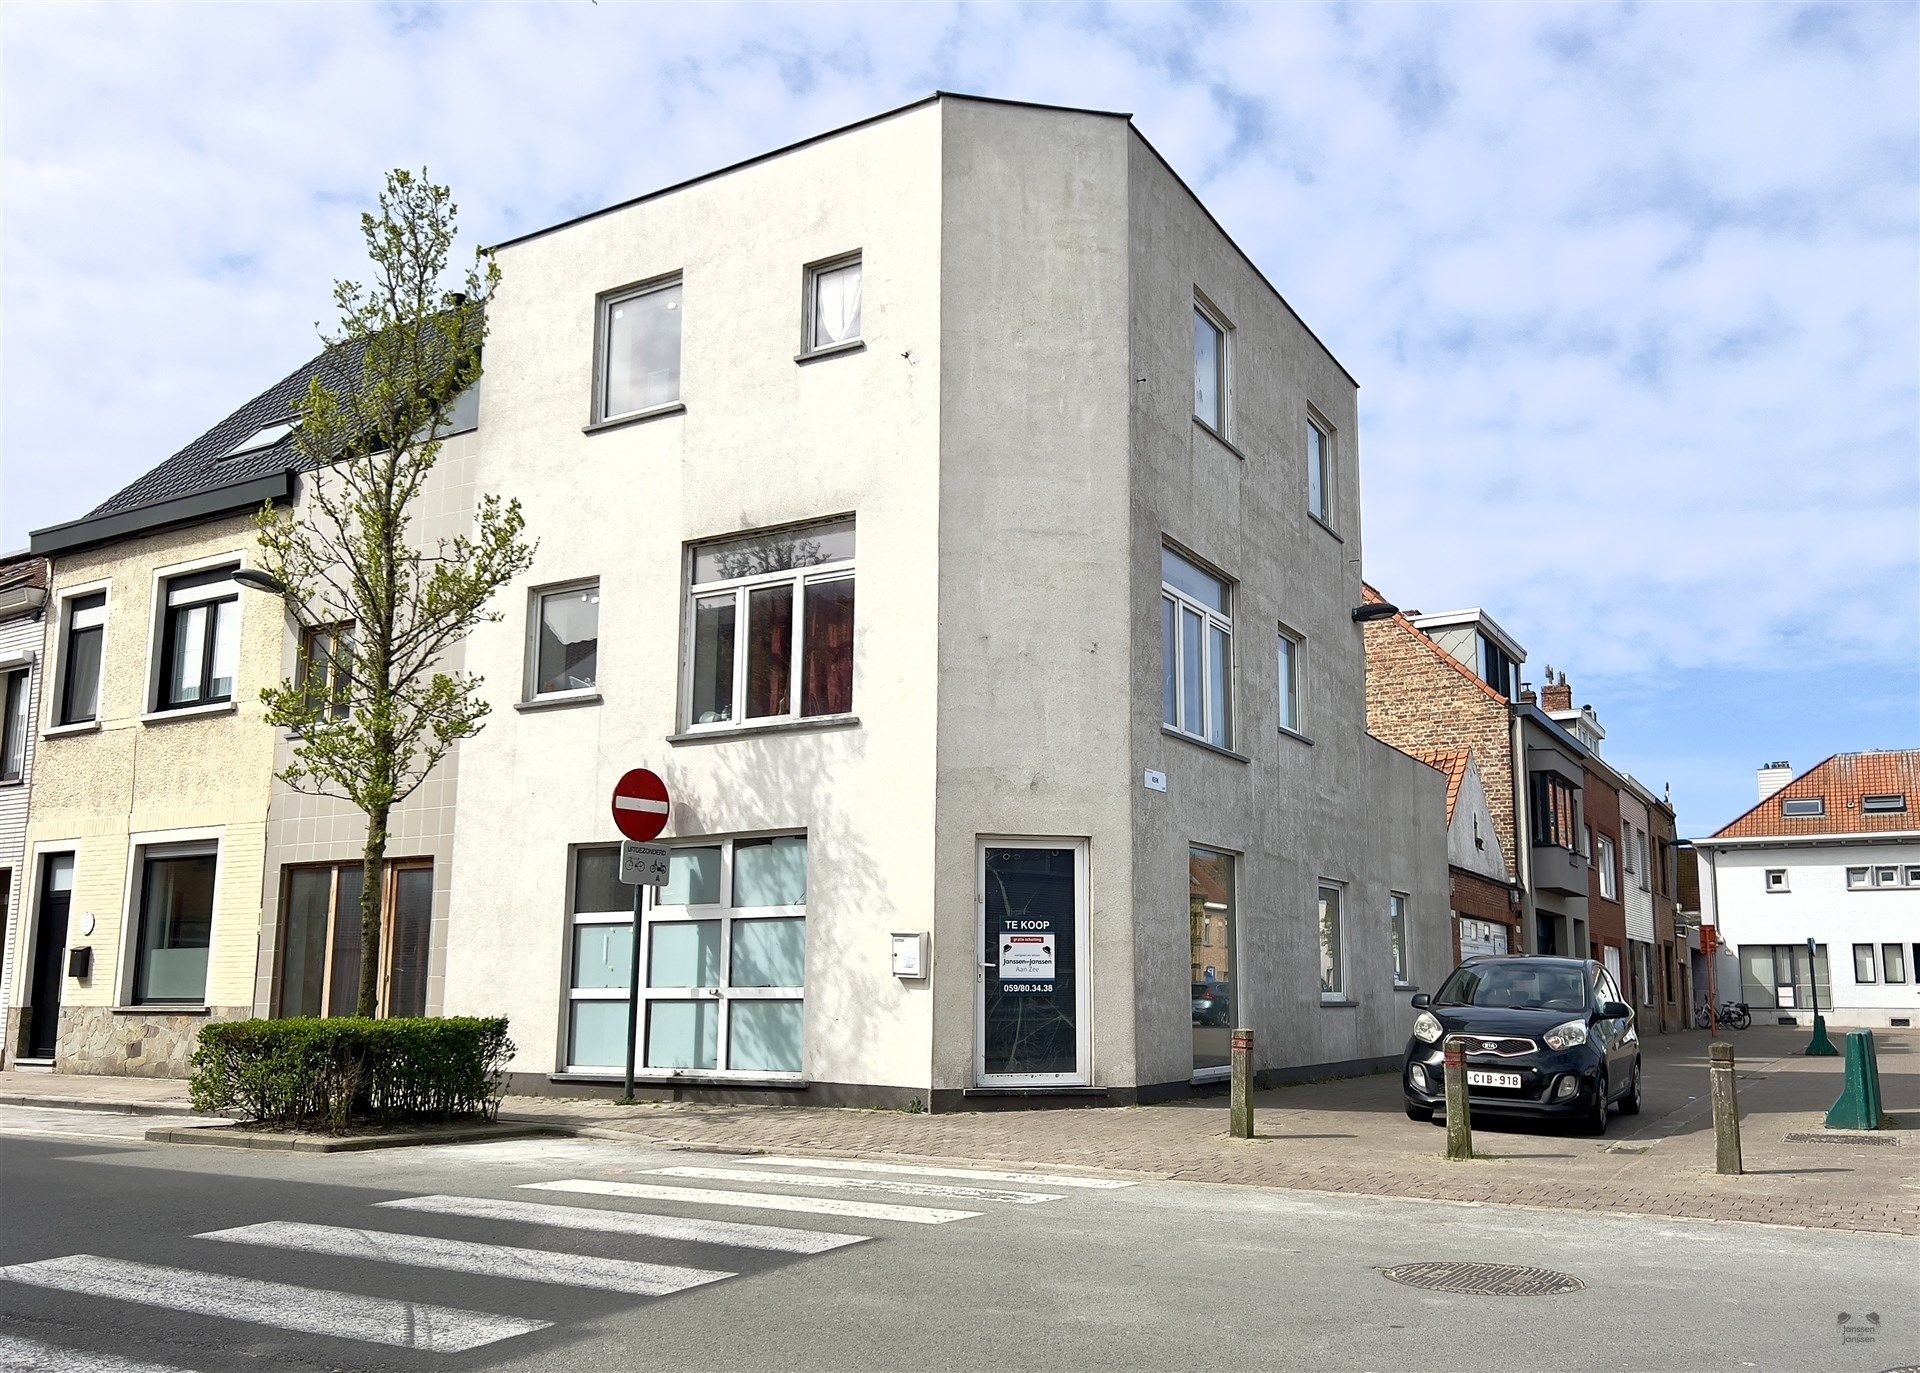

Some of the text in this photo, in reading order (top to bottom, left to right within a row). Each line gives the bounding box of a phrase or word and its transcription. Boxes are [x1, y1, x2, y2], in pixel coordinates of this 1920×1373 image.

[628, 846, 667, 856] UITGEZONDERD
[1005, 921, 1050, 930] TE KOOP
[1003, 984, 1053, 993] 059/80.34.38
